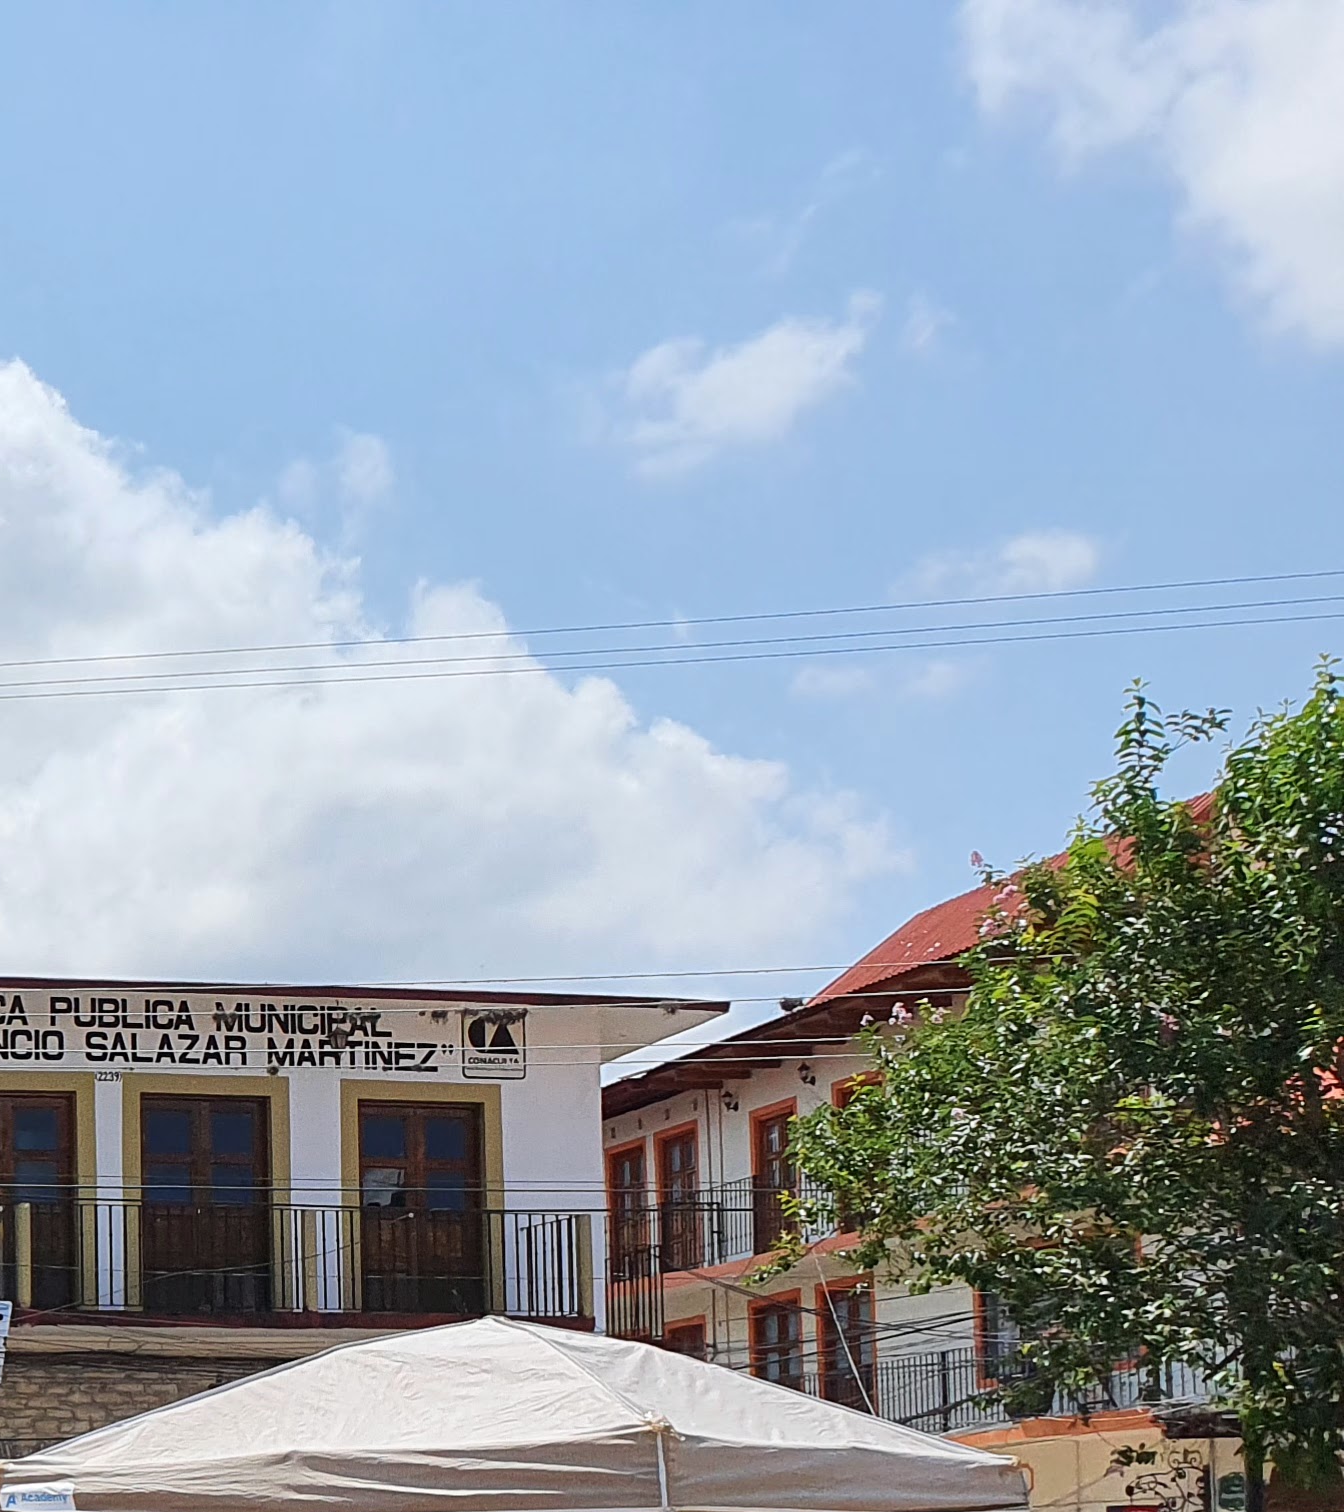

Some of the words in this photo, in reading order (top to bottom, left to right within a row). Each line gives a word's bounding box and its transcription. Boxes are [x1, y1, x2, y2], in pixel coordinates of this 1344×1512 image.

[49, 996, 195, 1032] PUBLICA
[215, 1001, 394, 1039] MUNICIPAL
[85, 1030, 247, 1067] SALAZAR
[21, 1492, 69, 1504] Academy
